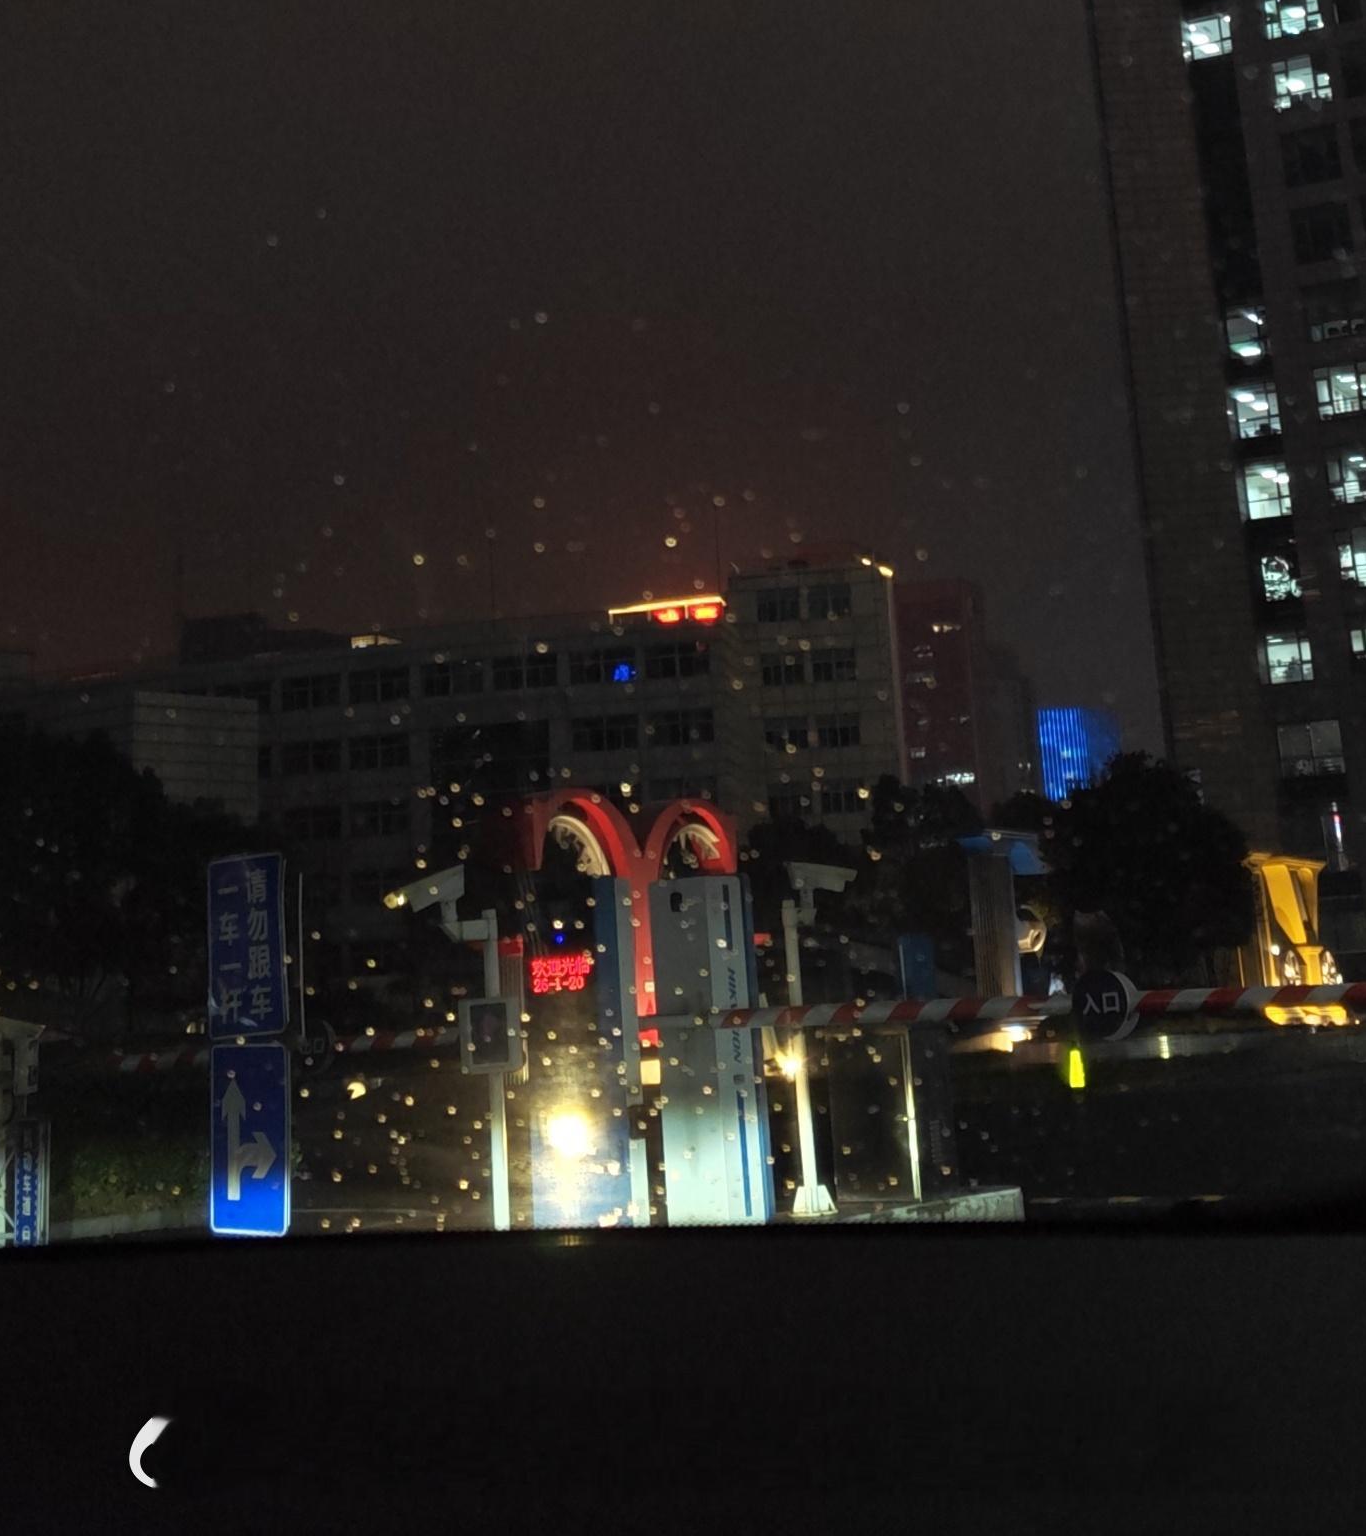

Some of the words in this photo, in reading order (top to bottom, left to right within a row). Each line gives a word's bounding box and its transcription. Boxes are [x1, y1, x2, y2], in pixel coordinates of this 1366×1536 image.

[217, 885, 244, 1025] 一车一杆
[246, 868, 274, 1021] 请勿跟车
[531, 954, 592, 978] 欢迎光临
[533, 975, 586, 993] 26-1-20
[1082, 991, 1121, 1016] 入口
